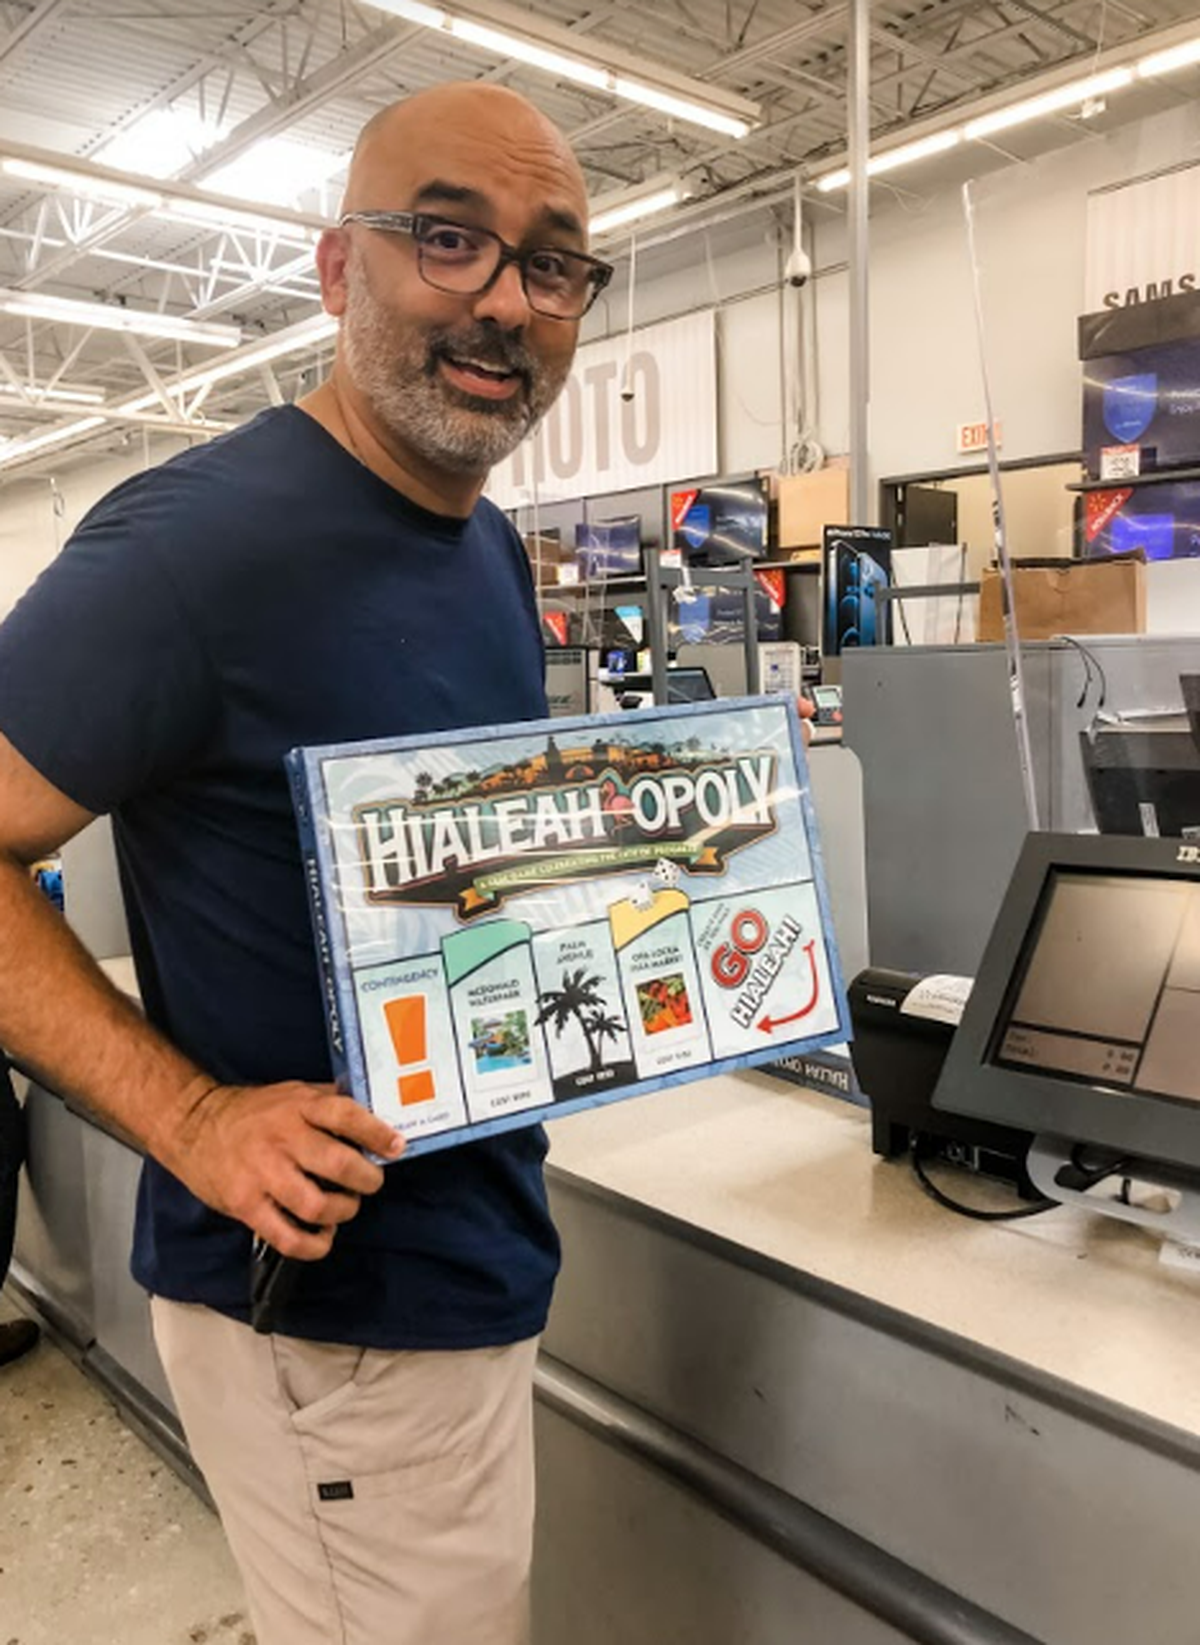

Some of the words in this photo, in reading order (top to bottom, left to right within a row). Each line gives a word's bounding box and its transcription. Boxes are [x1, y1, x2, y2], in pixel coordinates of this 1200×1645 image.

[363, 787, 606, 892] HIALEAH
[631, 757, 772, 831] OPOLY
[711, 909, 770, 990] GO
